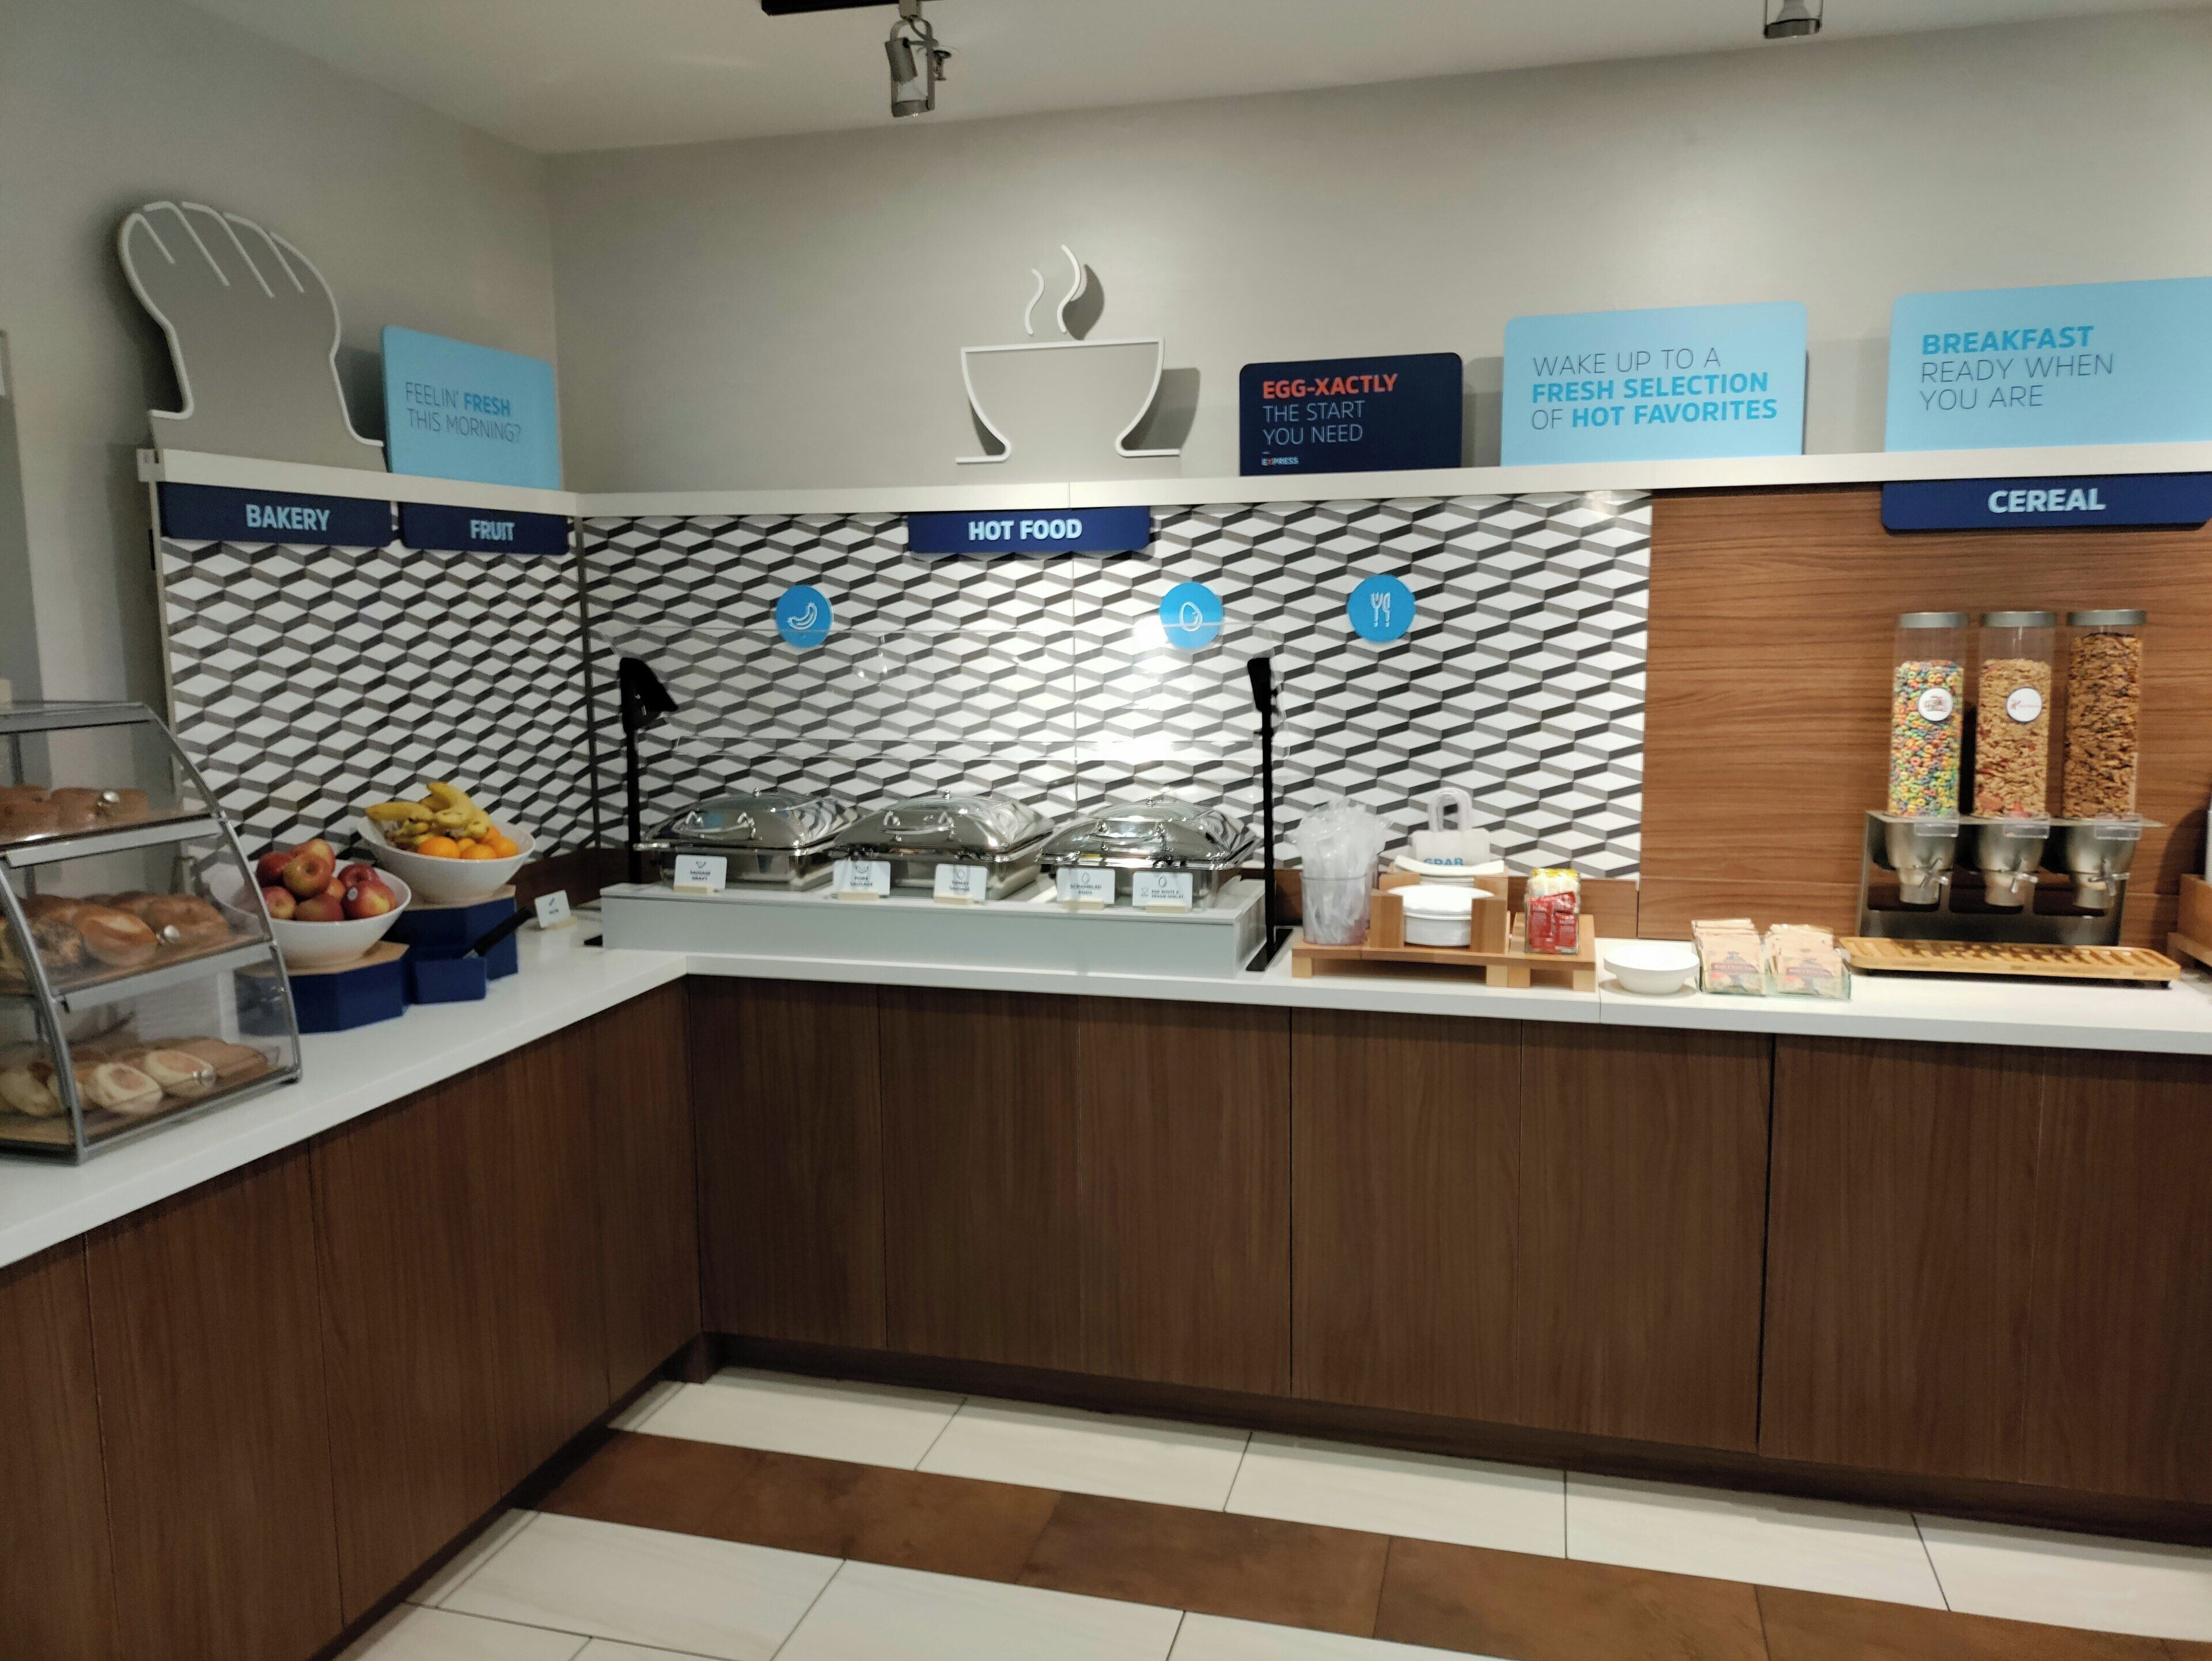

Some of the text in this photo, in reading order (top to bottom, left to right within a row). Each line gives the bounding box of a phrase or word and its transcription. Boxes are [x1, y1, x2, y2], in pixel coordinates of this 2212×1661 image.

[1922, 326, 2094, 355] BREAKFAST
[1532, 347, 1721, 377] WAKE UP TO A
[1922, 353, 2113, 383] READY WHEN
[406, 381, 511, 418] FEELIN' FRESH
[1263, 373, 1398, 399] EGG-XACTLY
[1532, 372, 1768, 403] FRESH SELECTION
[1920, 384, 2043, 411] YOU ARE
[407, 407, 521, 442] THIS MORNING?
[1262, 399, 1365, 423] THE START
[1531, 399, 1778, 430] OF HOT FAVORITES
[1262, 423, 1363, 446] YOU NEED
[1987, 488, 2107, 513] CEREAL
[245, 504, 331, 532] BAKERY
[469, 519, 515, 542] FRUIT
[968, 519, 1082, 541] HOT FOOD
